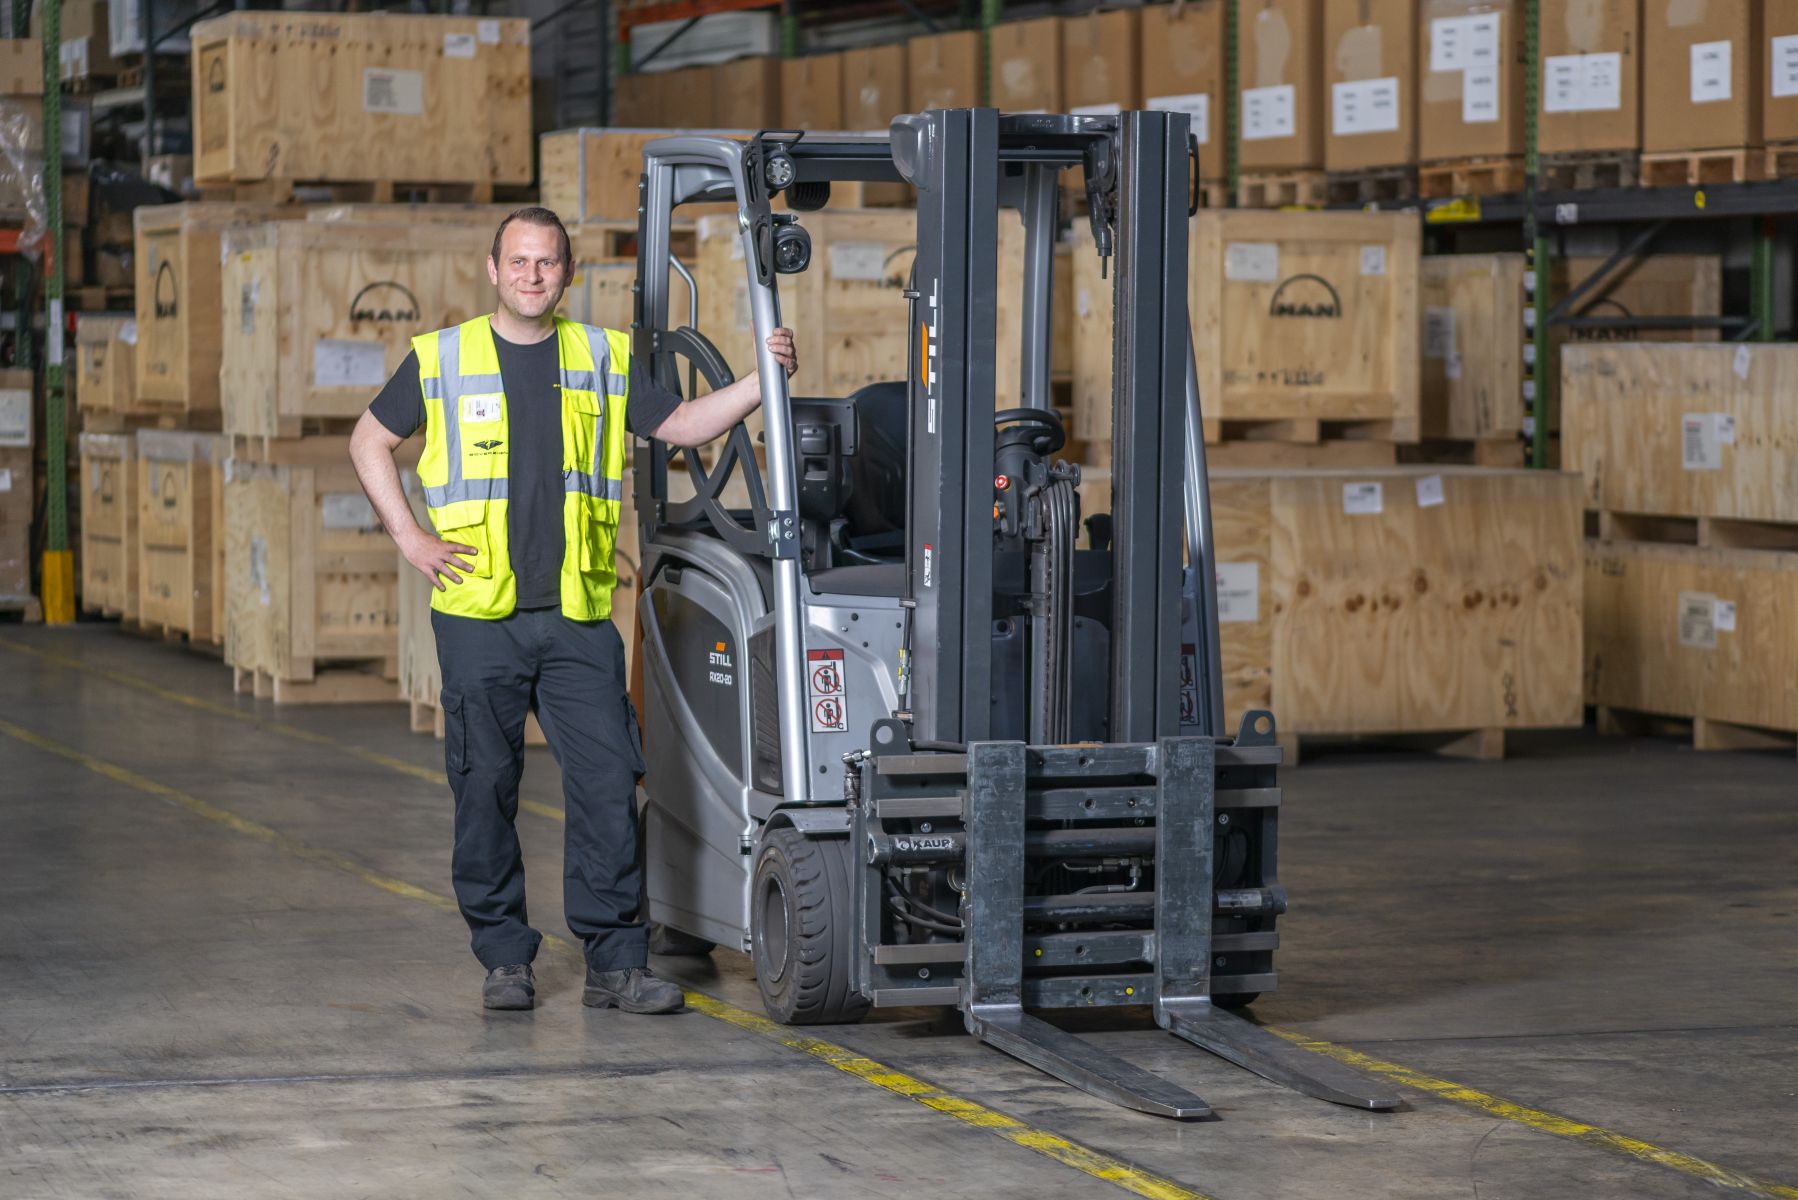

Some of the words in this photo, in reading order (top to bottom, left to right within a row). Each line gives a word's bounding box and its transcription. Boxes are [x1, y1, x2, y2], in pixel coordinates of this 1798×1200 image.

[356, 310, 414, 321] MAN
[1277, 303, 1334, 317] MAN
[928, 278, 938, 433] STILL
[709, 651, 732, 667] STILL
[709, 671, 732, 686] RX20-20
[913, 839, 951, 848] KAUP
